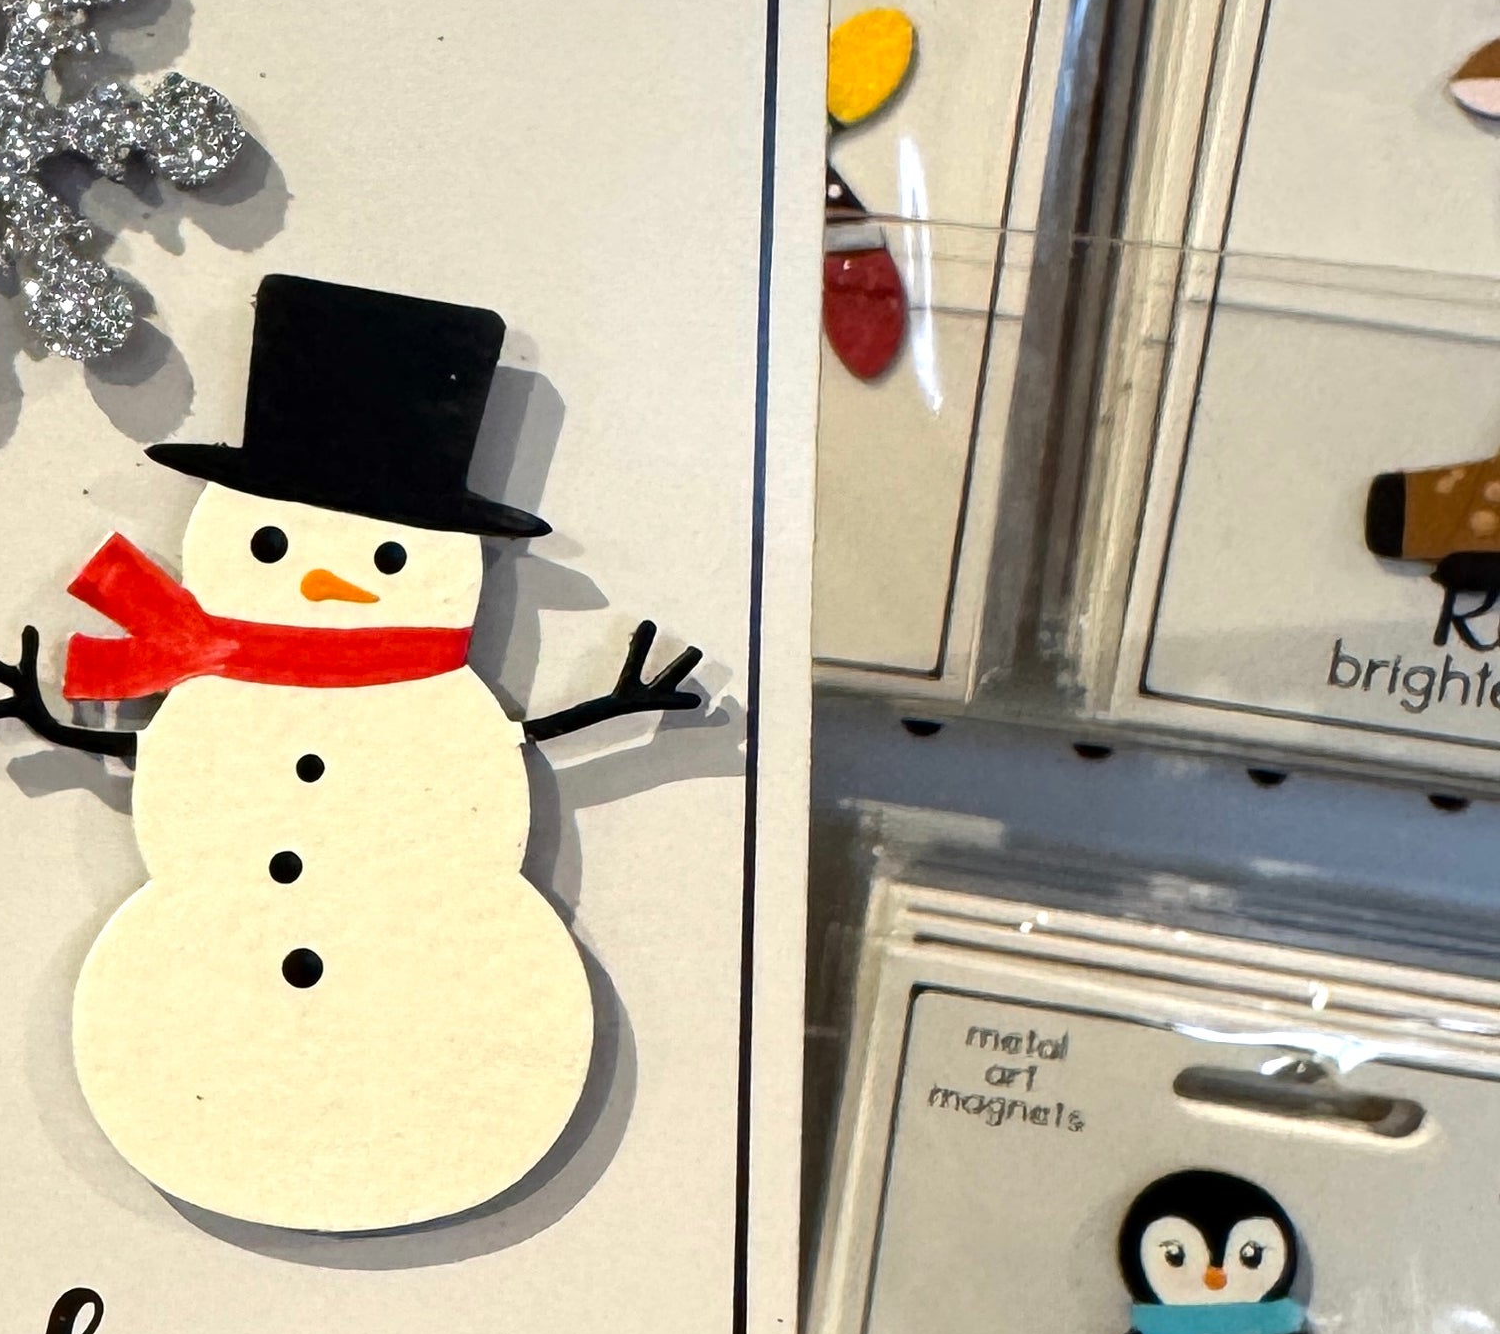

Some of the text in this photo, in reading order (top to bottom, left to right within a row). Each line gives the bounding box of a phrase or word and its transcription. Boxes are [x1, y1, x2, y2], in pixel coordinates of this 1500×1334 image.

[965, 1025, 1070, 1060] metal
[985, 1063, 1038, 1092] art
[928, 1082, 1086, 1133] magnets
